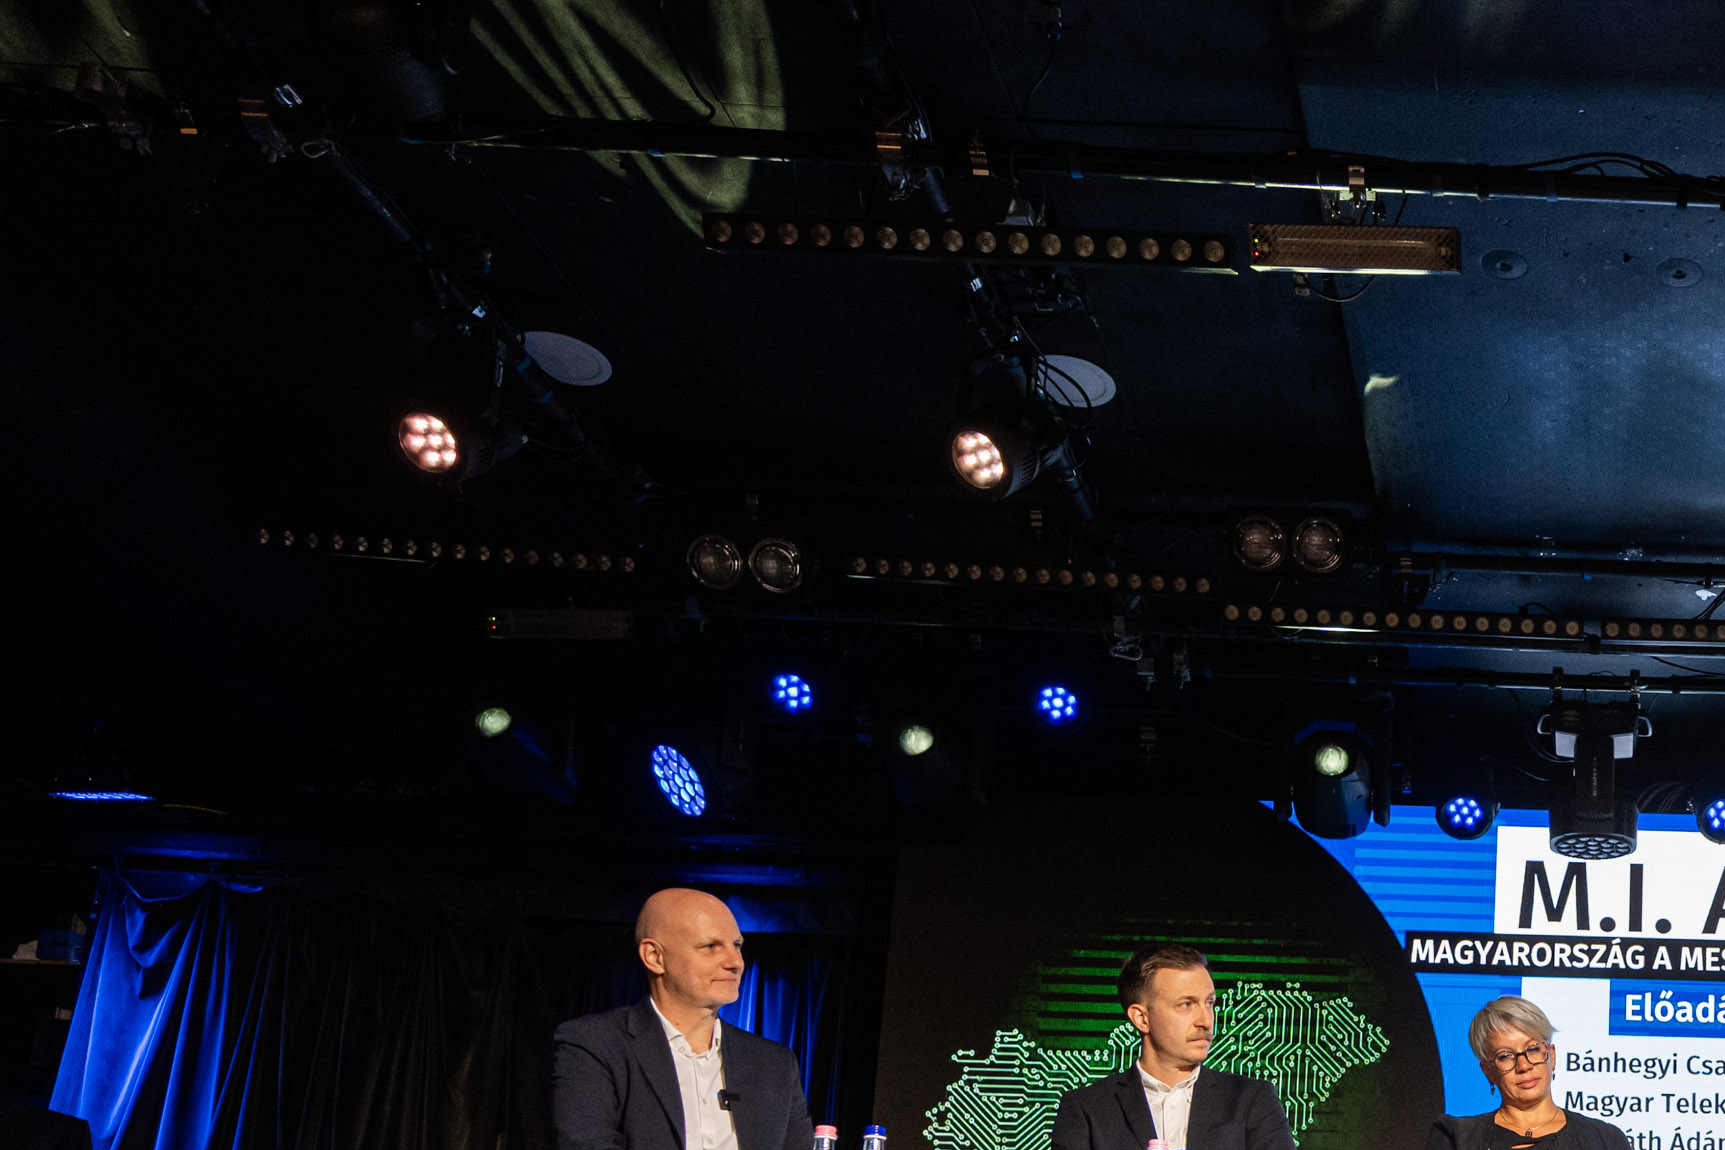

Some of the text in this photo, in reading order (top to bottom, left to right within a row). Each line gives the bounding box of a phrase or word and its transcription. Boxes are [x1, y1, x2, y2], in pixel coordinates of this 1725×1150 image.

[1518, 860, 1672, 934] M.I.
[1410, 938, 1645, 971] MAGYARORSZÁG
[1653, 945, 1673, 970] A
[1566, 1050, 1678, 1079] Bánhegyi
[1565, 1091, 1655, 1117] Magyar
